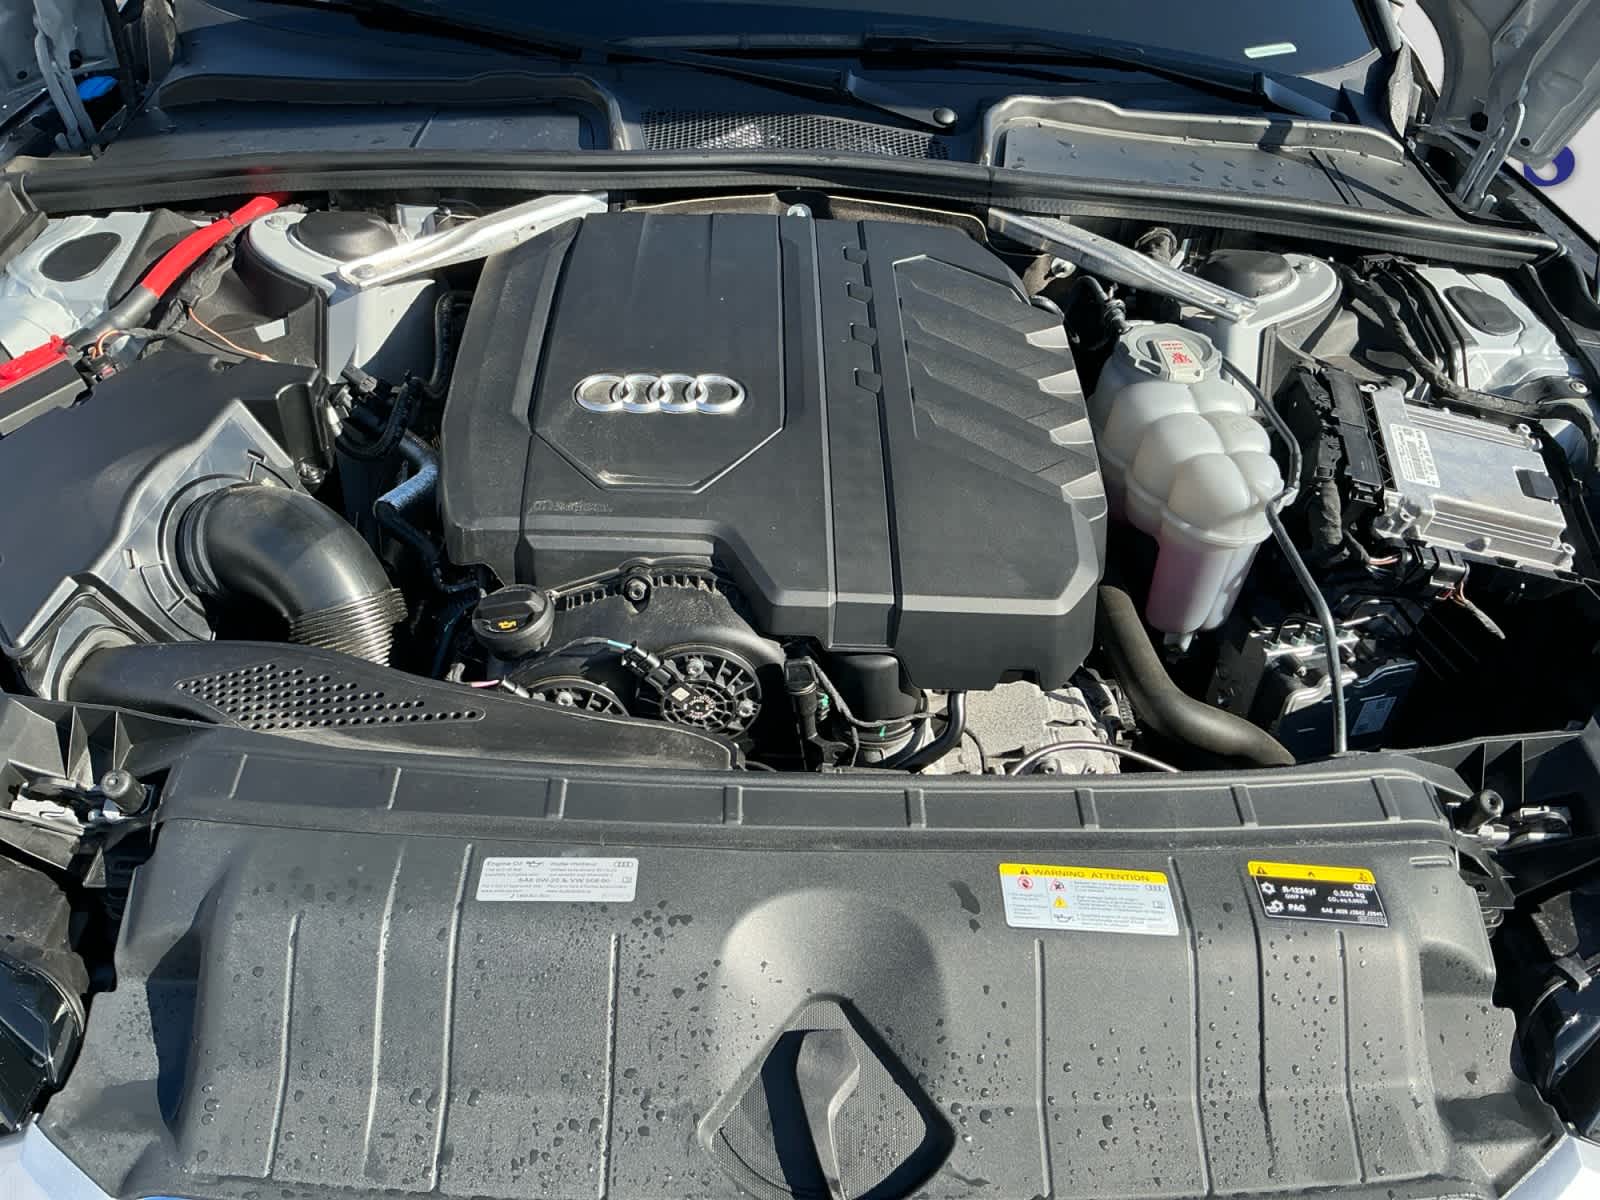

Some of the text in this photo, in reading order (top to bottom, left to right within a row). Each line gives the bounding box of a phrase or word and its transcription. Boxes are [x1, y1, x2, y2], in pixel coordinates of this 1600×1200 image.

[1033, 868, 1151, 883] WARNING ATTENTION
[1287, 903, 1307, 912] PAG
